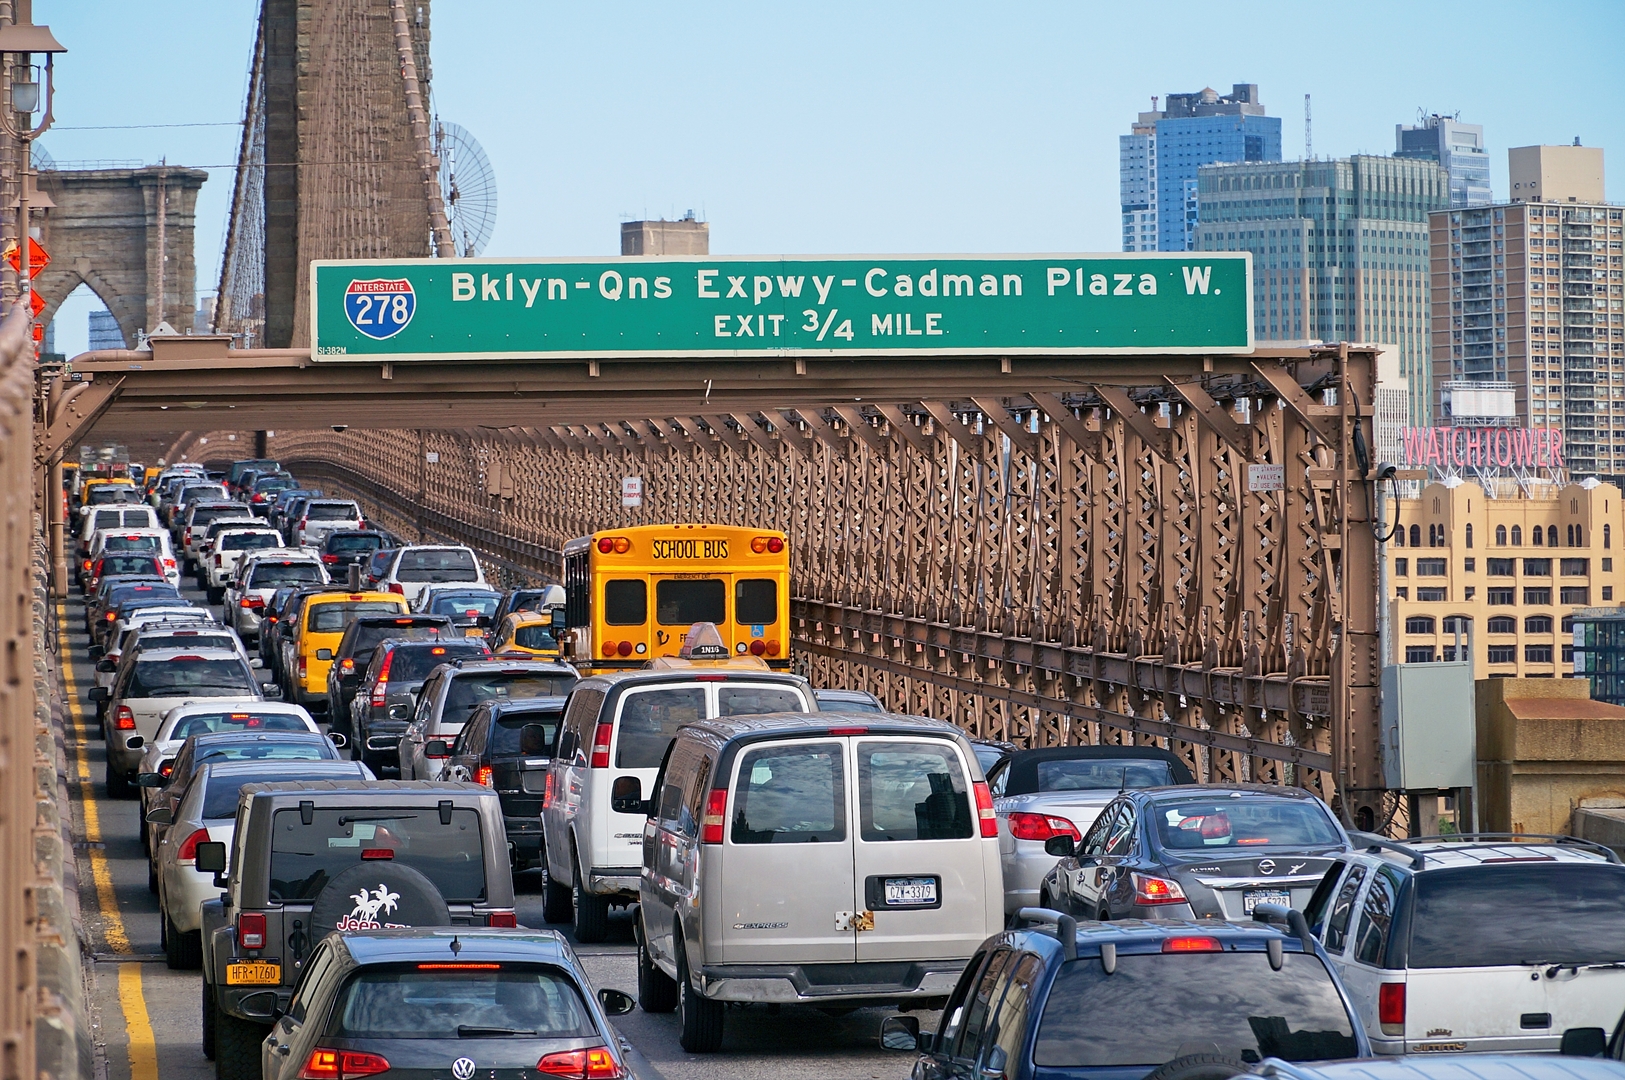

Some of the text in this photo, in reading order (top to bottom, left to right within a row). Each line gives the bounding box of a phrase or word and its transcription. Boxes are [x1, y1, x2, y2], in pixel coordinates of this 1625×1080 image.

[354, 283, 405, 292] INTERSTATE
[452, 266, 1222, 308] Bklyn-Qns Expwy-Cadman Plaza W.
[356, 294, 408, 325] 278
[714, 308, 943, 342] EXIT 3/4 MILE
[1402, 426, 1564, 467] WATCHTOWER
[653, 540, 728, 559] SCHOOL BUS
[701, 646, 720, 654] 1N16
[337, 915, 381, 931] Jeep
[1413, 1042, 1467, 1052] JIMMY
